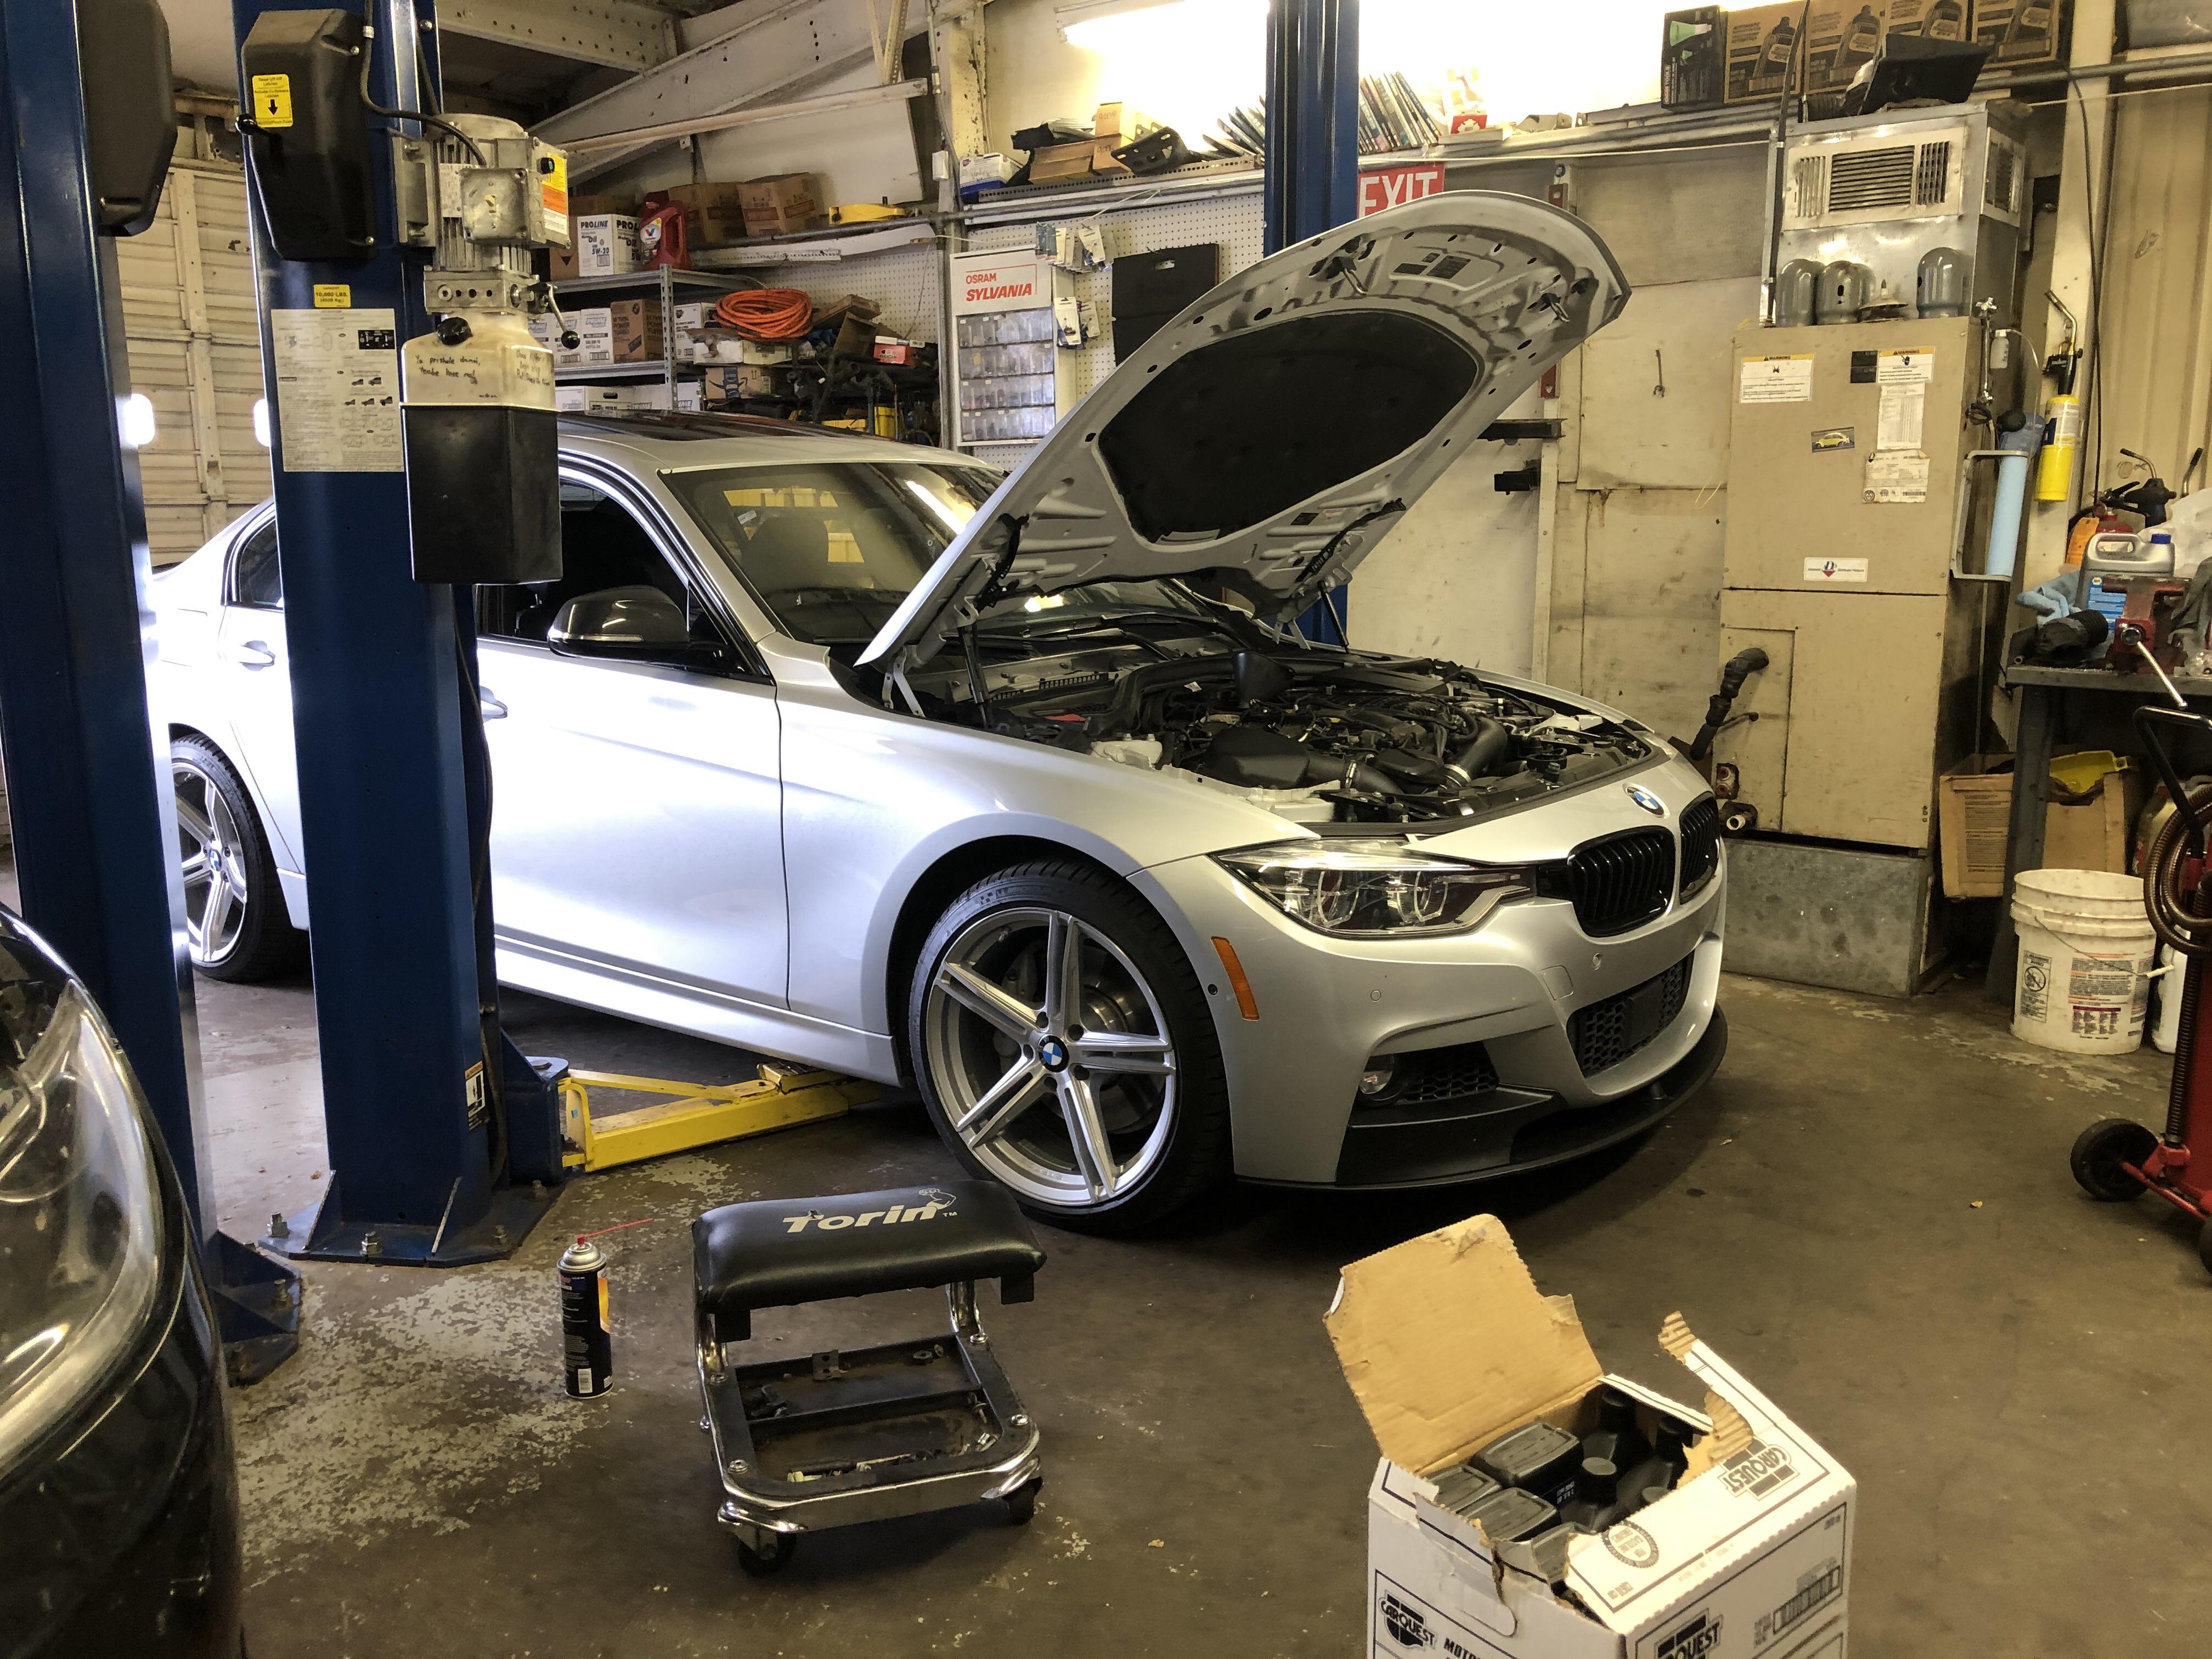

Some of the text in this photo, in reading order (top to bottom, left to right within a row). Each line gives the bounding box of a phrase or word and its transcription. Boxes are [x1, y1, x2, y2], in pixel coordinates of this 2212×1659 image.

[580, 220, 608, 229] PROLINE
[591, 247, 610, 255] 5W-20
[966, 273, 997, 285] OSRAM
[966, 283, 1032, 302] SYLVANIA
[783, 1205, 937, 1234] Torin
[1722, 1447, 1787, 1493] CARQUEST
[1380, 1600, 1435, 1646] CARQUEST
